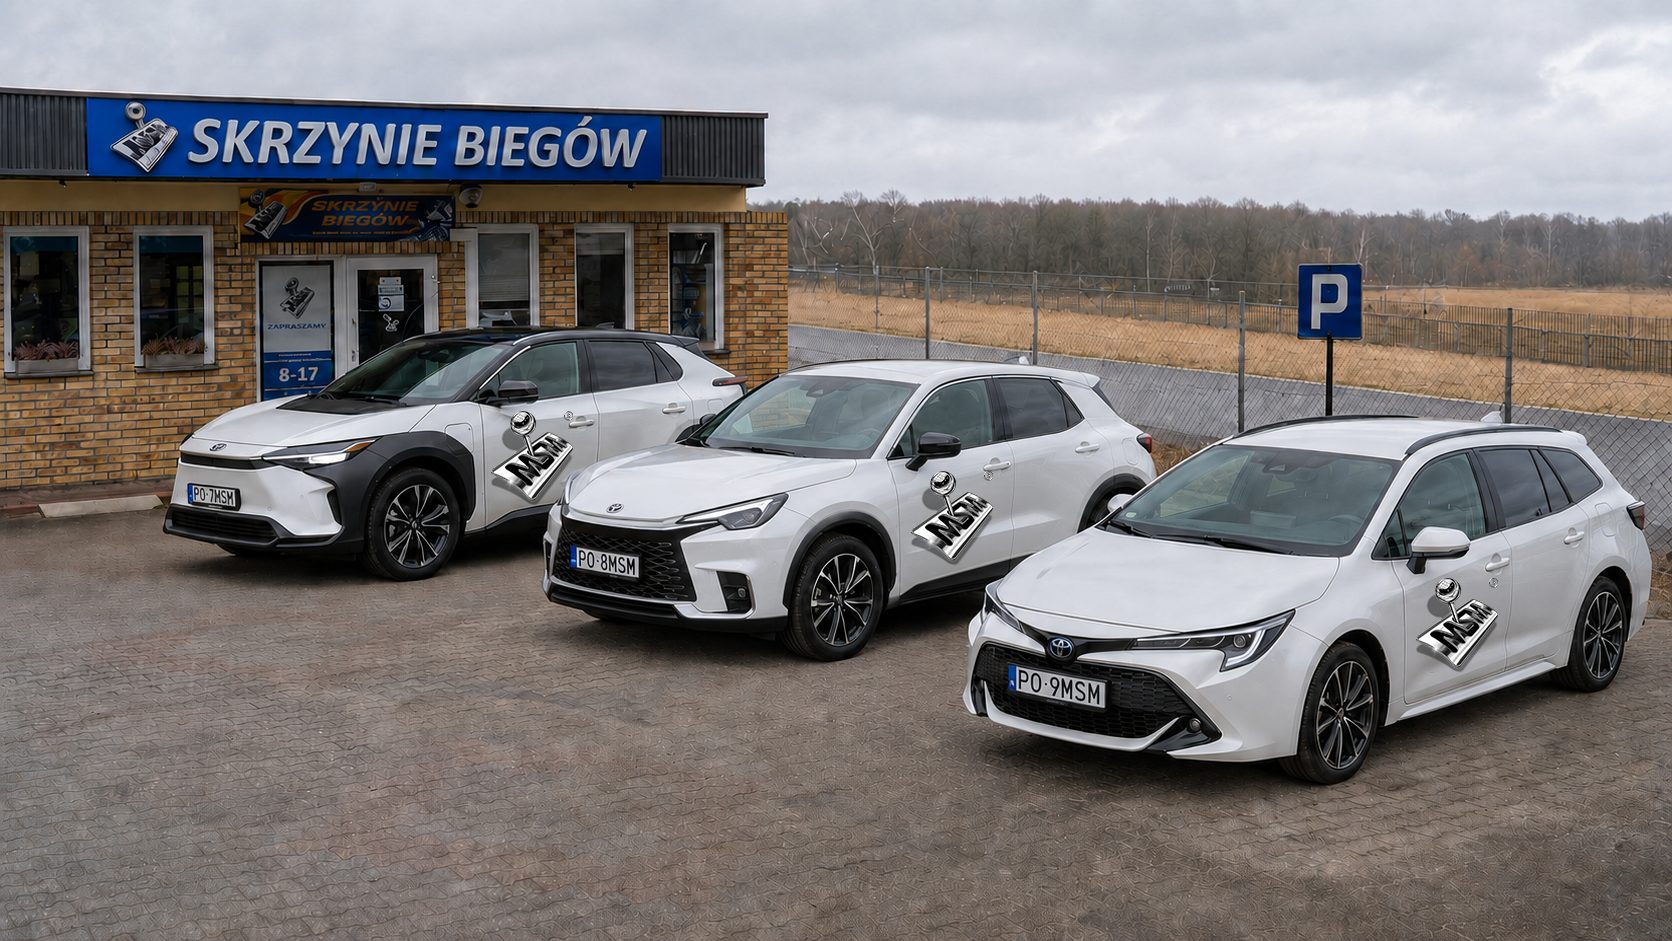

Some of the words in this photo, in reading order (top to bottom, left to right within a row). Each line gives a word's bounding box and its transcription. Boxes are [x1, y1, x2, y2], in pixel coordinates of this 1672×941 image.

[188, 118, 442, 166] SKRZYNIE
[454, 115, 648, 168] BIEGÓW
[311, 200, 419, 212] SKRZYNIE
[321, 213, 409, 226] BIEGÓW
[1311, 273, 1348, 330] P
[267, 322, 327, 330] ZAPRASZAMY
[278, 366, 319, 382] 8-17
